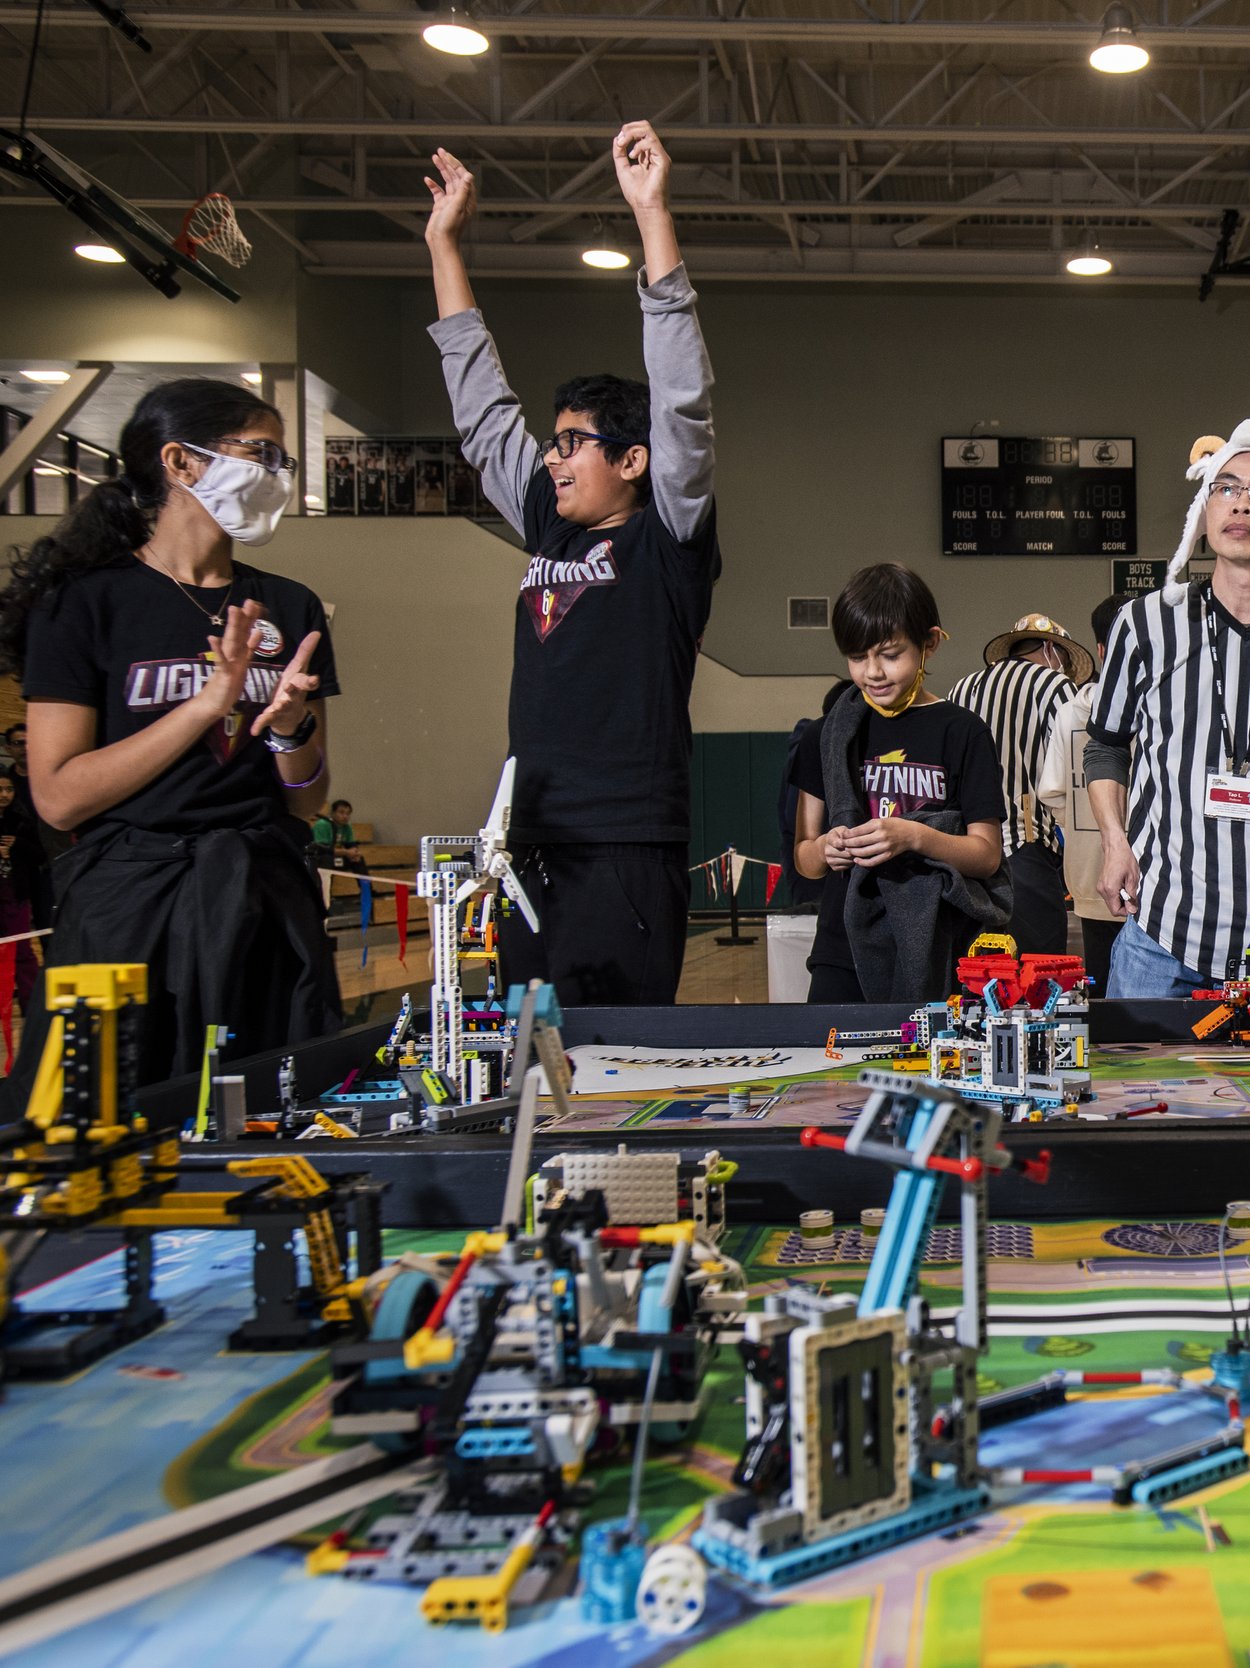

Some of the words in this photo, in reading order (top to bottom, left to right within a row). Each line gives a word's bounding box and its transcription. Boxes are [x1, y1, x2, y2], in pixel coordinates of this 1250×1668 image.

[1025, 475, 1053, 484] PERIOD
[952, 510, 977, 519] FOULS
[986, 510, 1007, 519] T.O.L.
[1015, 510, 1044, 519] PLAYER
[1046, 510, 1066, 519] FOUL
[1074, 510, 1094, 519] T.O.L.
[1101, 510, 1126, 519] FOULS
[952, 542, 977, 551] SCORE
[1026, 542, 1053, 551] MATCH
[1102, 542, 1127, 551] SCORE
[1129, 564, 1152, 574] BOYS
[1126, 577, 1156, 588] TRACK
[542, 588, 551, 616] 6
[864, 764, 947, 801] HTNING
[878, 796, 890, 819] 6
